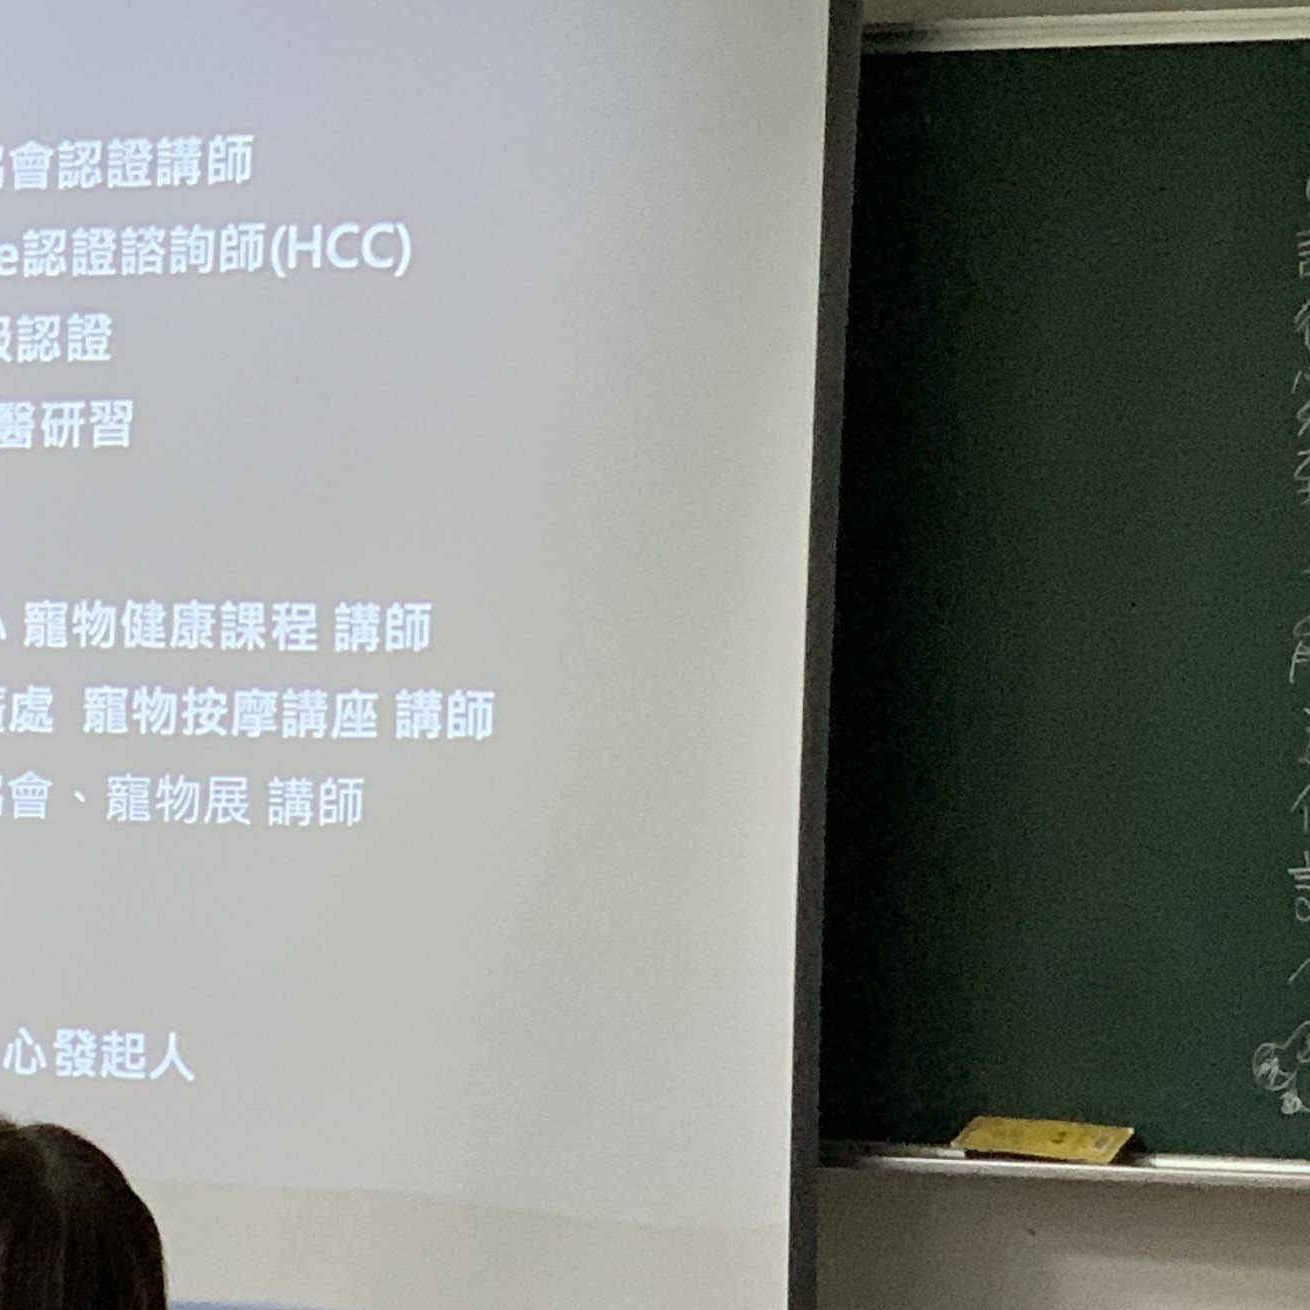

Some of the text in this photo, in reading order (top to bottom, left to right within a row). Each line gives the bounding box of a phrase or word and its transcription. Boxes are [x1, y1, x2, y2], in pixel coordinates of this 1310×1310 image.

[22, 599, 319, 653] 寵物健康課程
[333, 601, 433, 653] 講師
[82, 685, 380, 740] 寵物按摩講座
[394, 688, 496, 741] 講師
[267, 776, 366, 828] 講師
